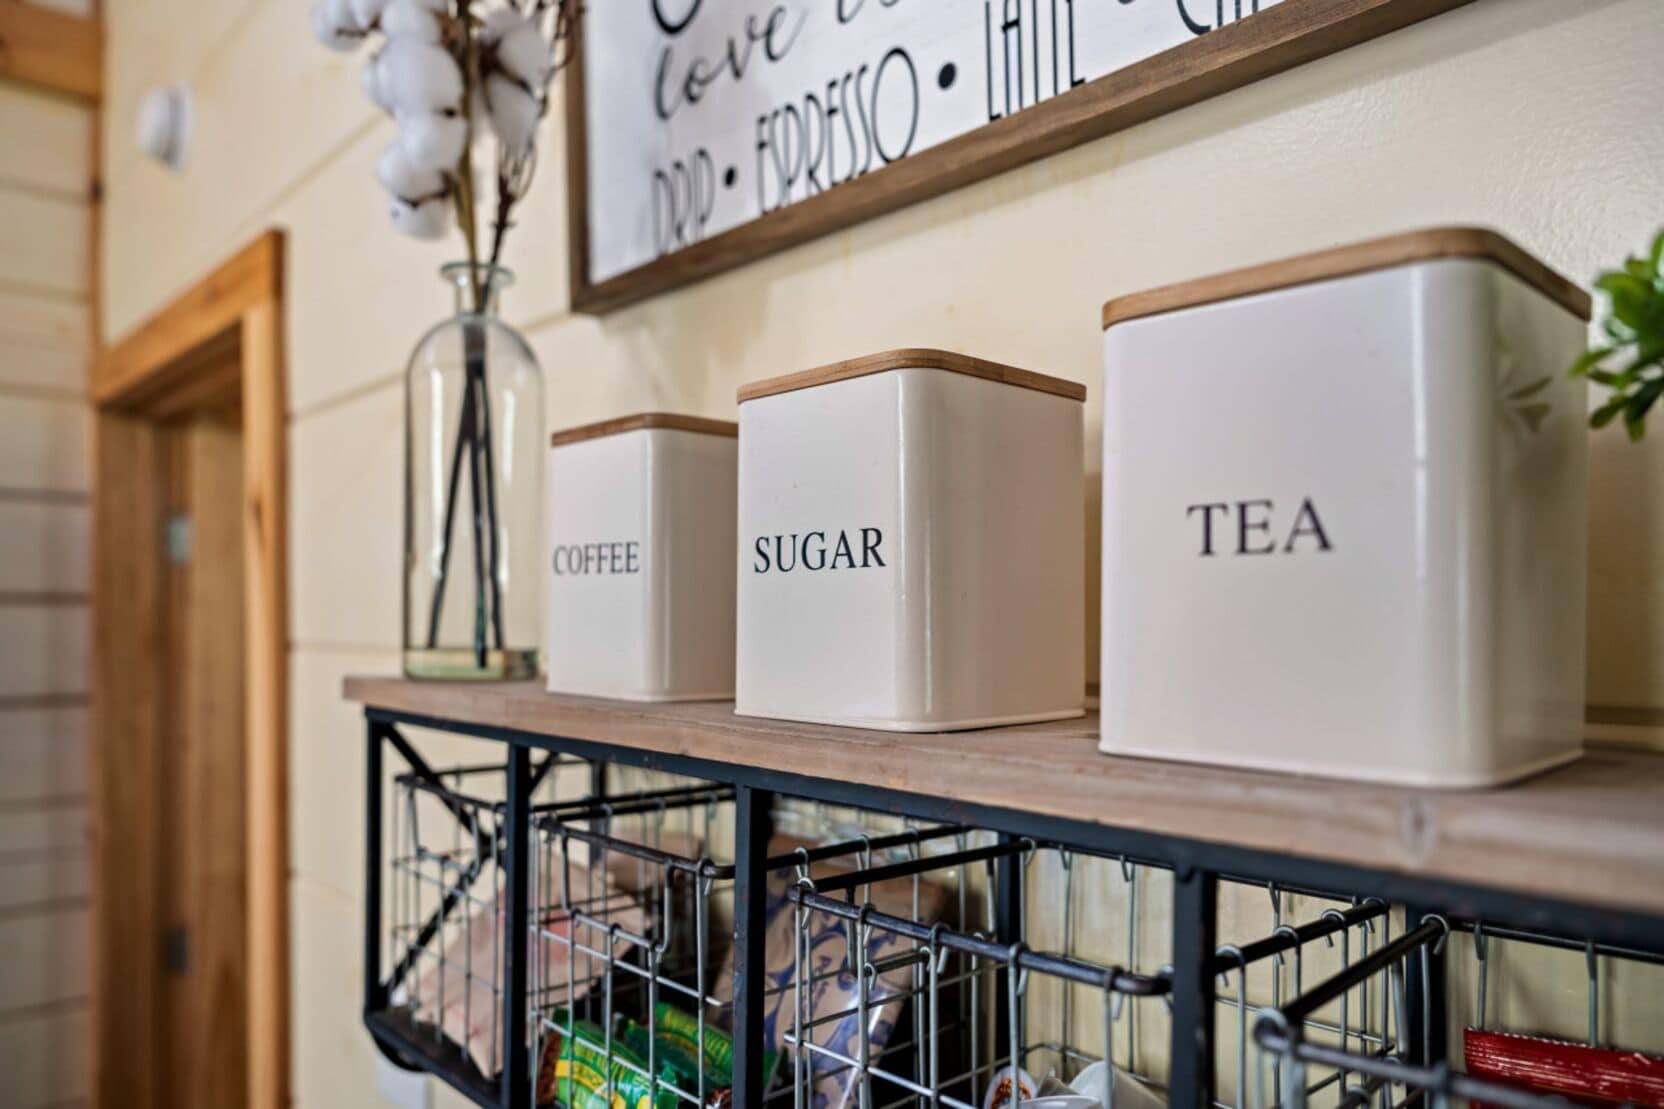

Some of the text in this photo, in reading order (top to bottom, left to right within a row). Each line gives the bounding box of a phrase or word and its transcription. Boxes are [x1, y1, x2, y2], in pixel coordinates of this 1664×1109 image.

[653, 6, 804, 121] love
[756, 47, 919, 216] ESPRESSO
[753, 527, 887, 574] SUGAR
[1186, 497, 1334, 556] TEA
[553, 541, 640, 575] COFFEE
